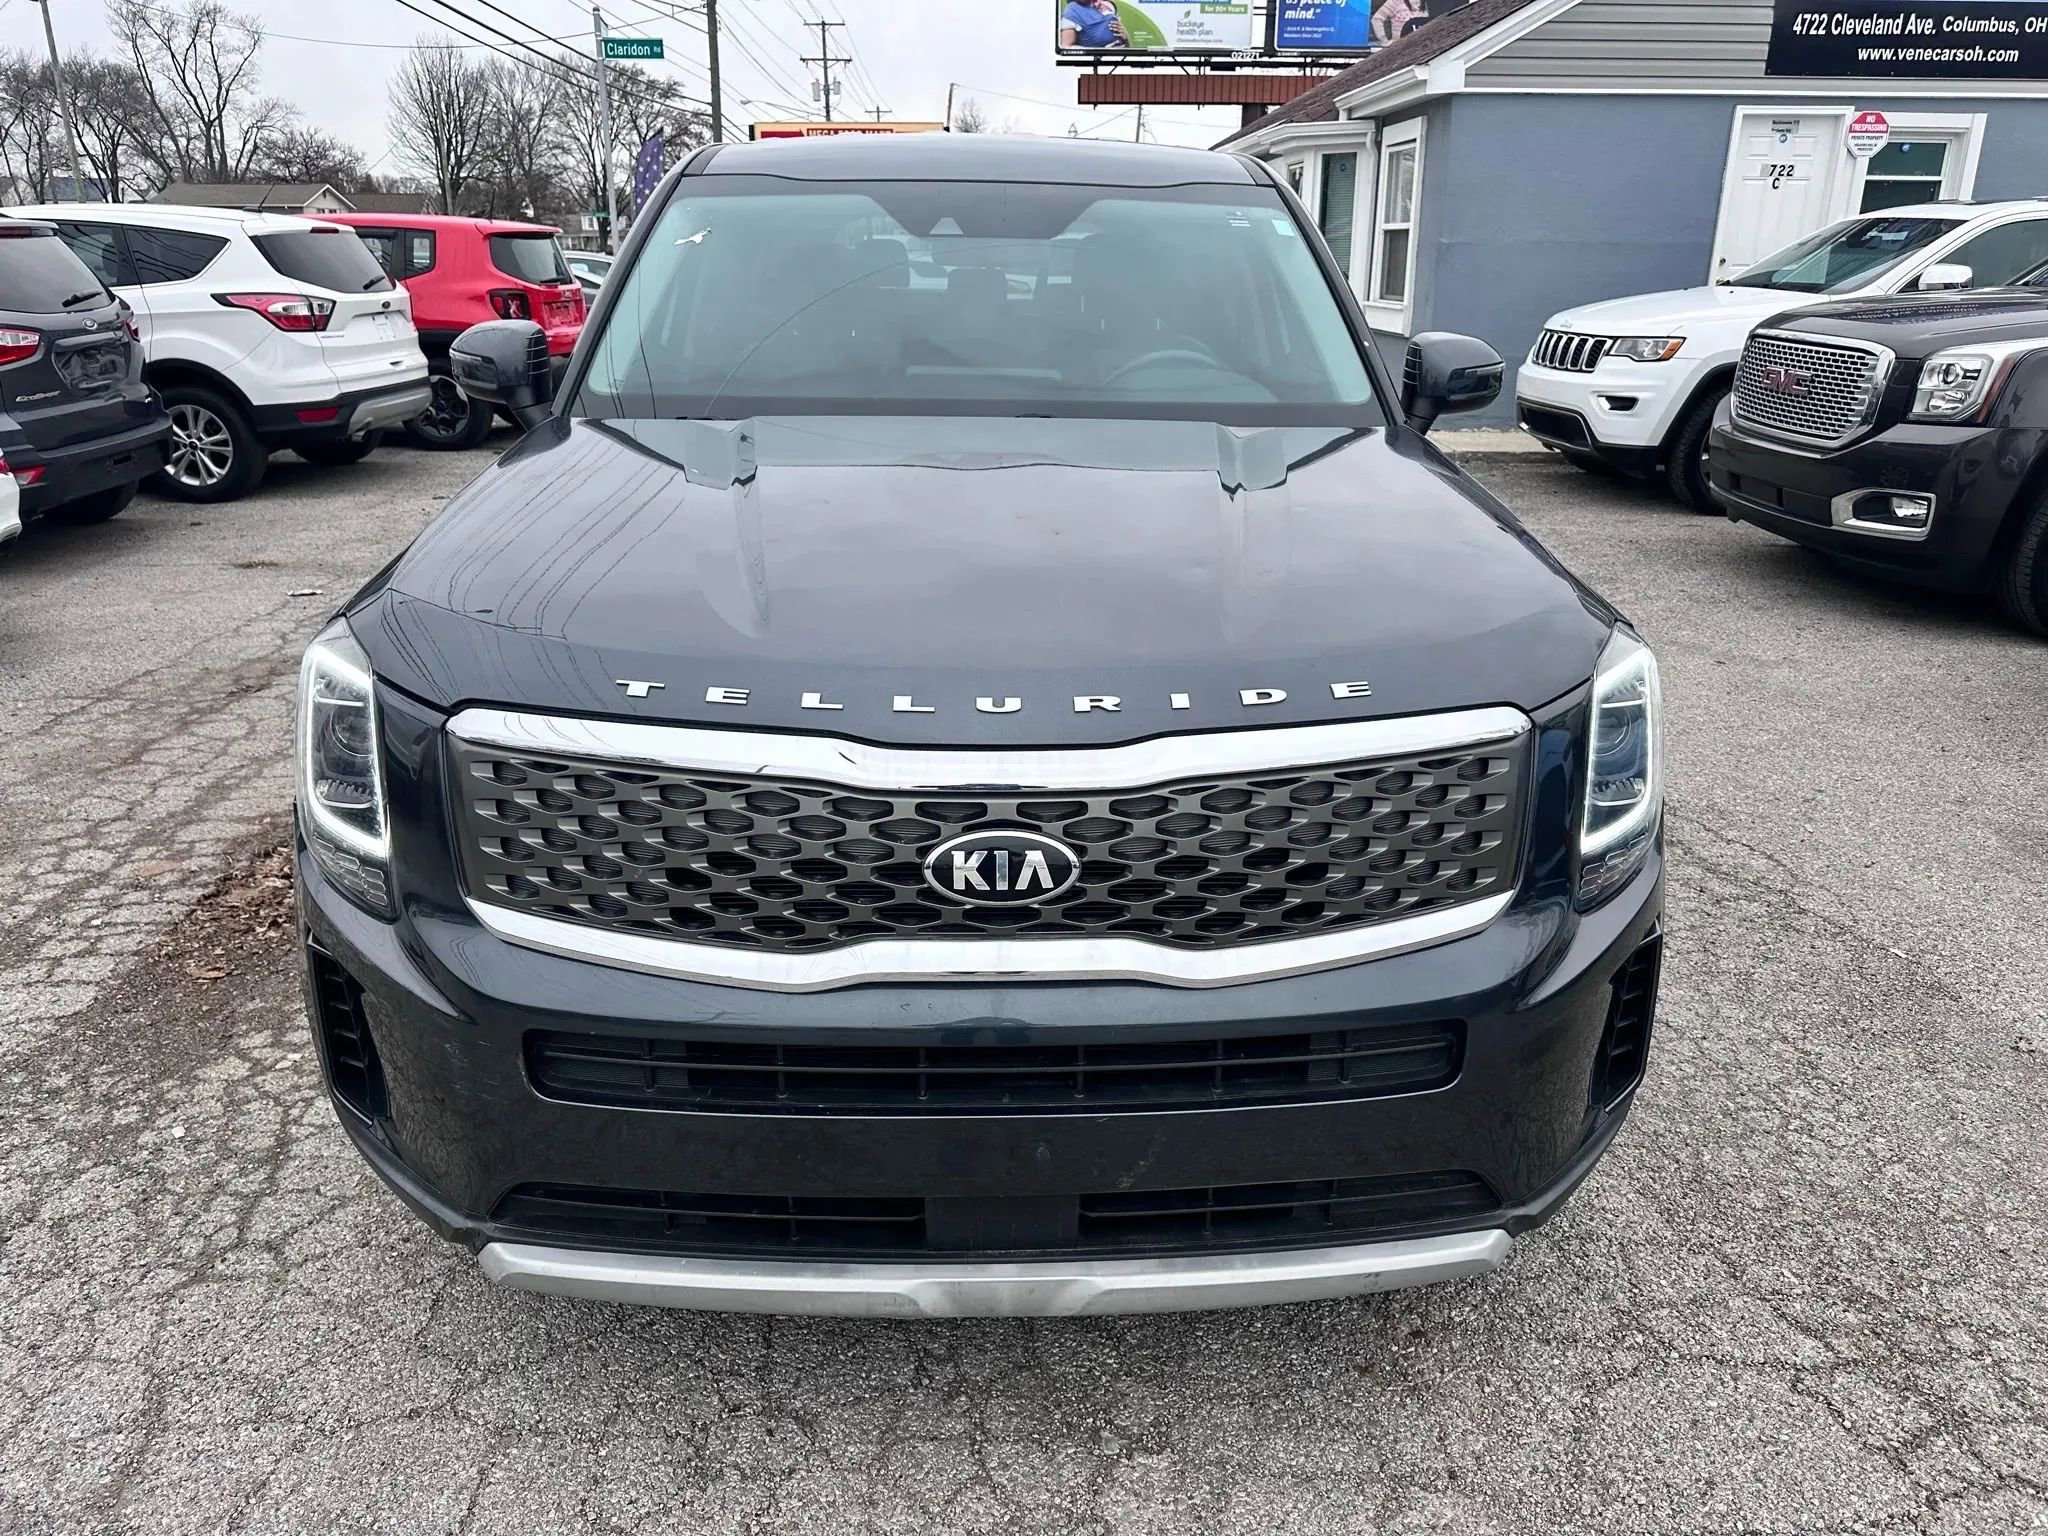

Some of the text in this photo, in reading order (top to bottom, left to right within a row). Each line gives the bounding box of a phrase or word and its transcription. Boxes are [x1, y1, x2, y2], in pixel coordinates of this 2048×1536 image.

[1176, 21, 1205, 29] buckeye
[1793, 12, 2048, 35] 4722 Cleveland Ave. Columbus, OH
[607, 42, 651, 56] Claridon
[1858, 46, 2019, 62] www.venecarsoh.com
[1865, 114, 1877, 123] NO
[1851, 123, 1888, 132] TRESPASSING
[1769, 164, 1794, 177] 722
[1772, 177, 1780, 190] C
[1763, 366, 1811, 396] GMC
[616, 679, 1373, 714] TELLURIDE
[951, 850, 1055, 891] KIA
